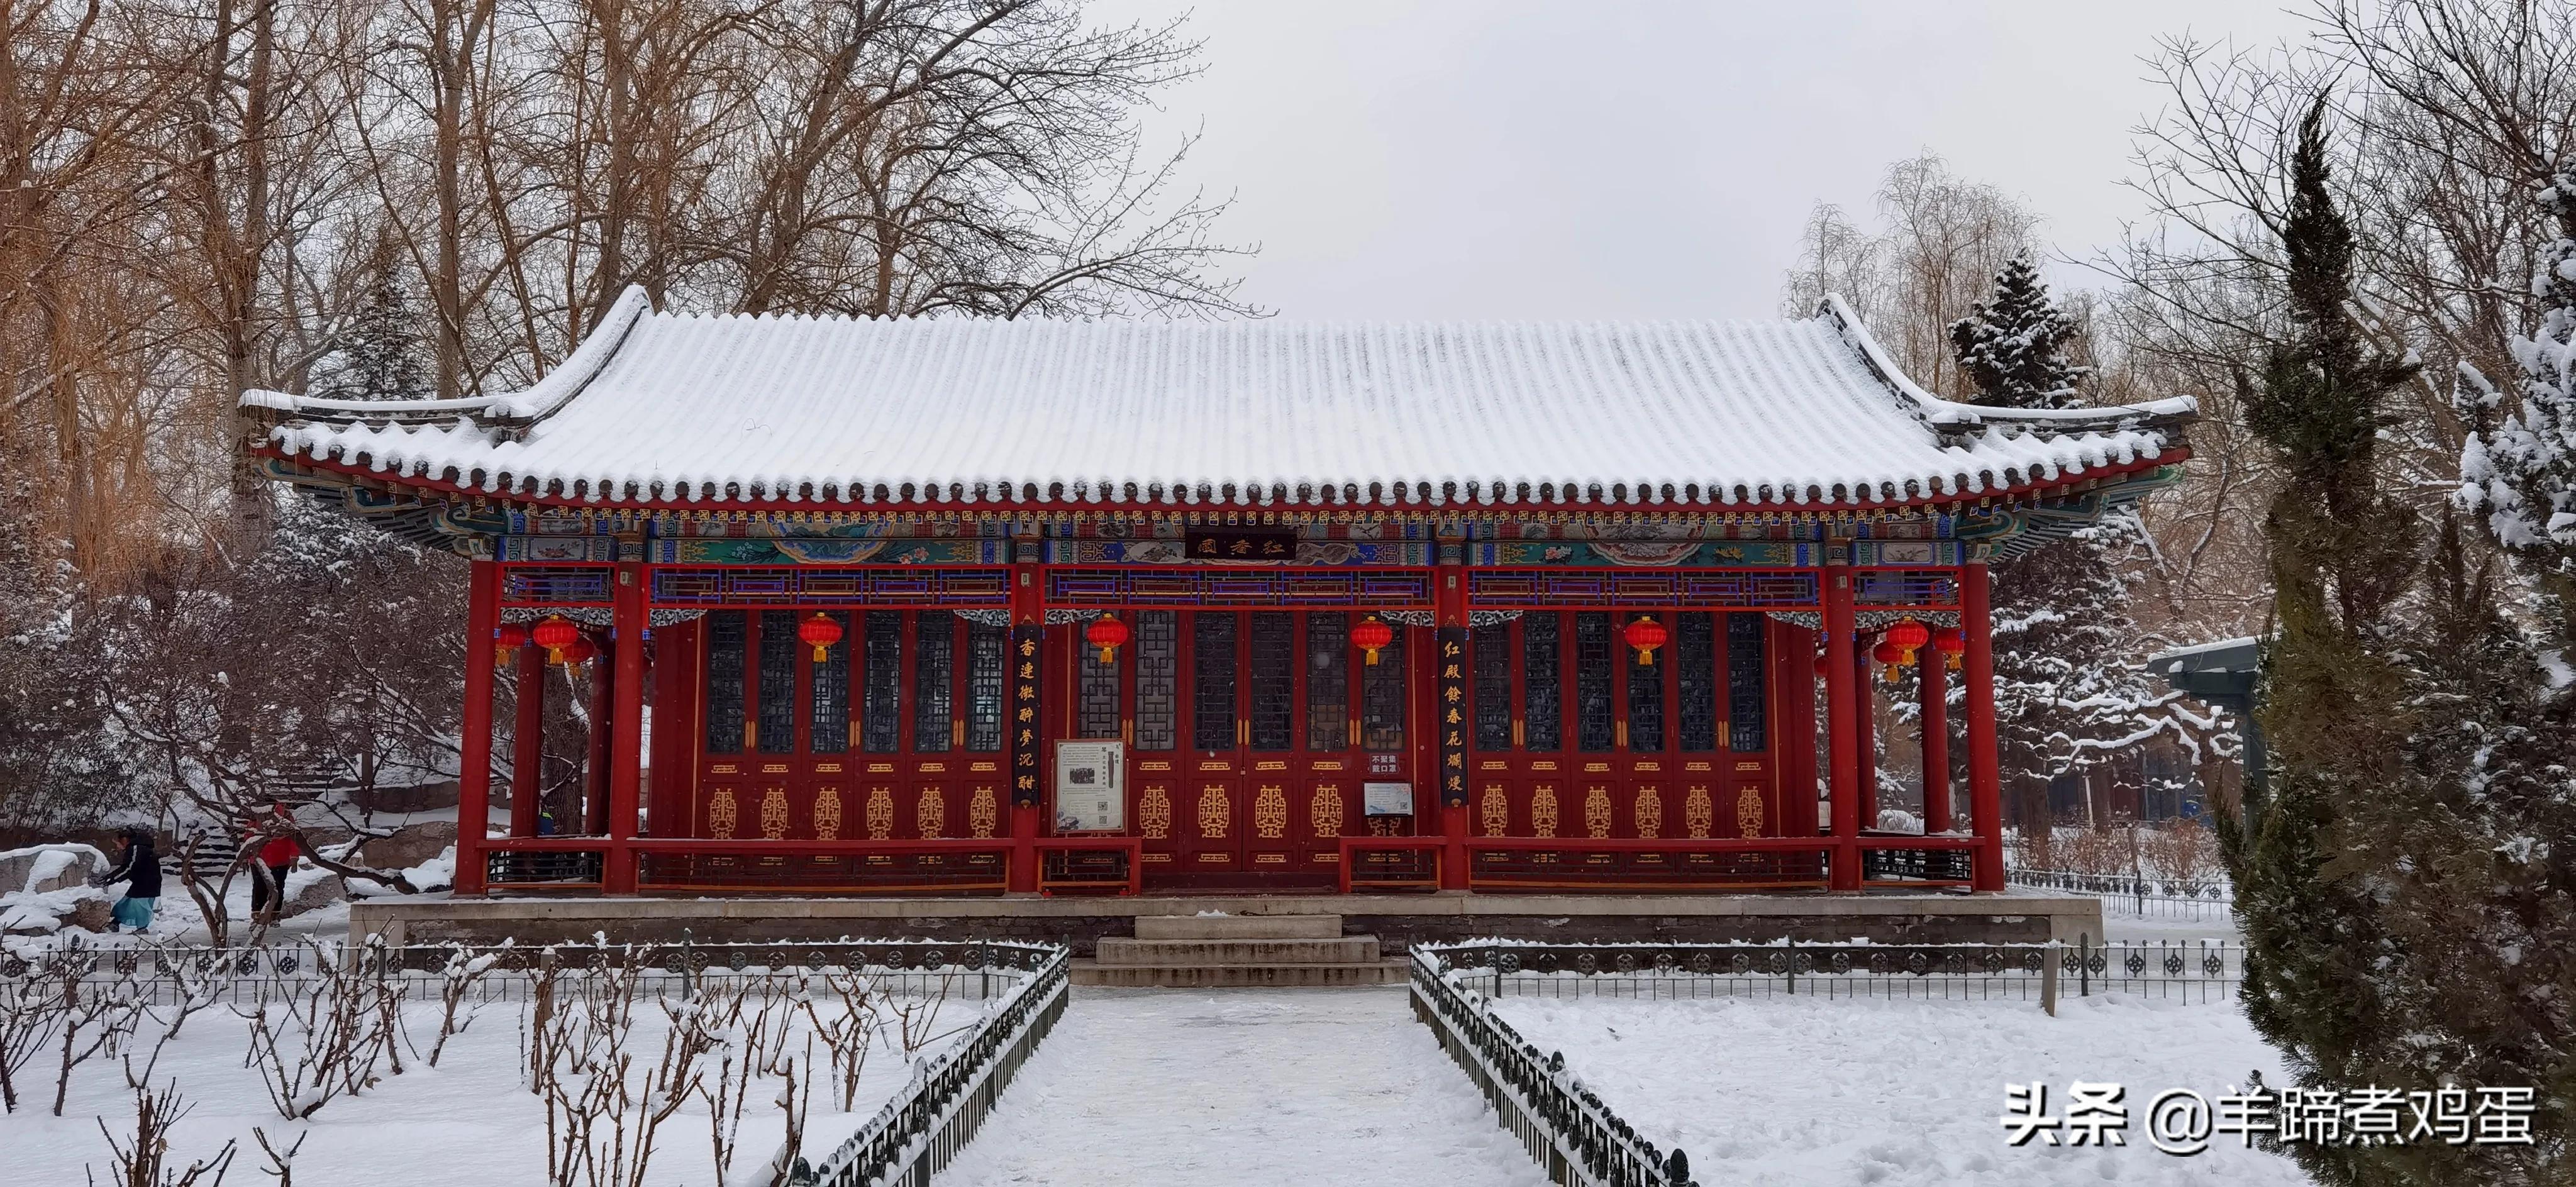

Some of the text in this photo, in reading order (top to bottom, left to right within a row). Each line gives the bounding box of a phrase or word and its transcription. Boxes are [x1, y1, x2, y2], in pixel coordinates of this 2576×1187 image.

[1372, 755, 1396, 763] 不聚集
[1372, 764, 1397, 773] 戴口罩
